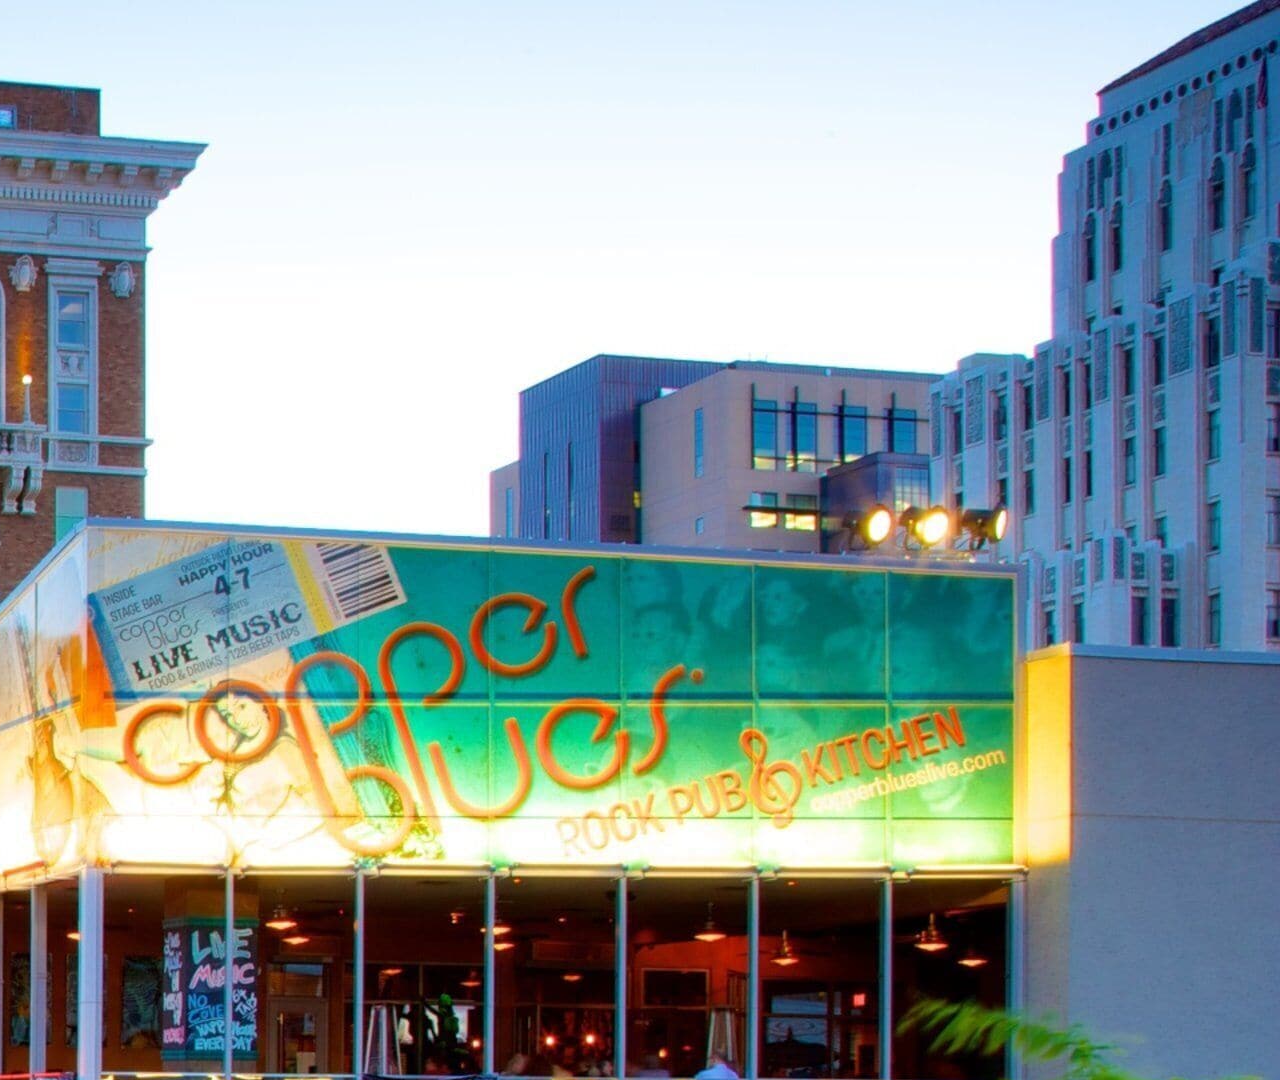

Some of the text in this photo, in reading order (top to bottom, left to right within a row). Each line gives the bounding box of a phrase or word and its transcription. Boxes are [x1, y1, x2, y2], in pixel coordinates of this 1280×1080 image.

[179, 542, 274, 587] HAPPY HOUR
[103, 585, 136, 606] INSIDE
[214, 567, 252, 596] 4-7
[110, 594, 163, 623] STAGE BAR
[120, 606, 187, 642] copper
[132, 602, 303, 681] LIVE MUSIC
[148, 672, 176, 690] FOOD
[187, 655, 224, 677] DRINKS
[230, 647, 249, 662] 128
[249, 636, 275, 655] BEER
[274, 625, 302, 644] TAPS
[124, 566, 595, 815] copper
[555, 792, 665, 858] ROCK
[667, 769, 747, 826] PUB
[801, 706, 966, 790] KITCHEN
[810, 749, 1007, 814] copperblueslive.com
[188, 963, 255, 990] MUSIC
[188, 993, 209, 1009] NO
[188, 1005, 225, 1023] COVE
[195, 1020, 225, 1037] HAPP
[194, 1036, 253, 1051] EVERDAY
